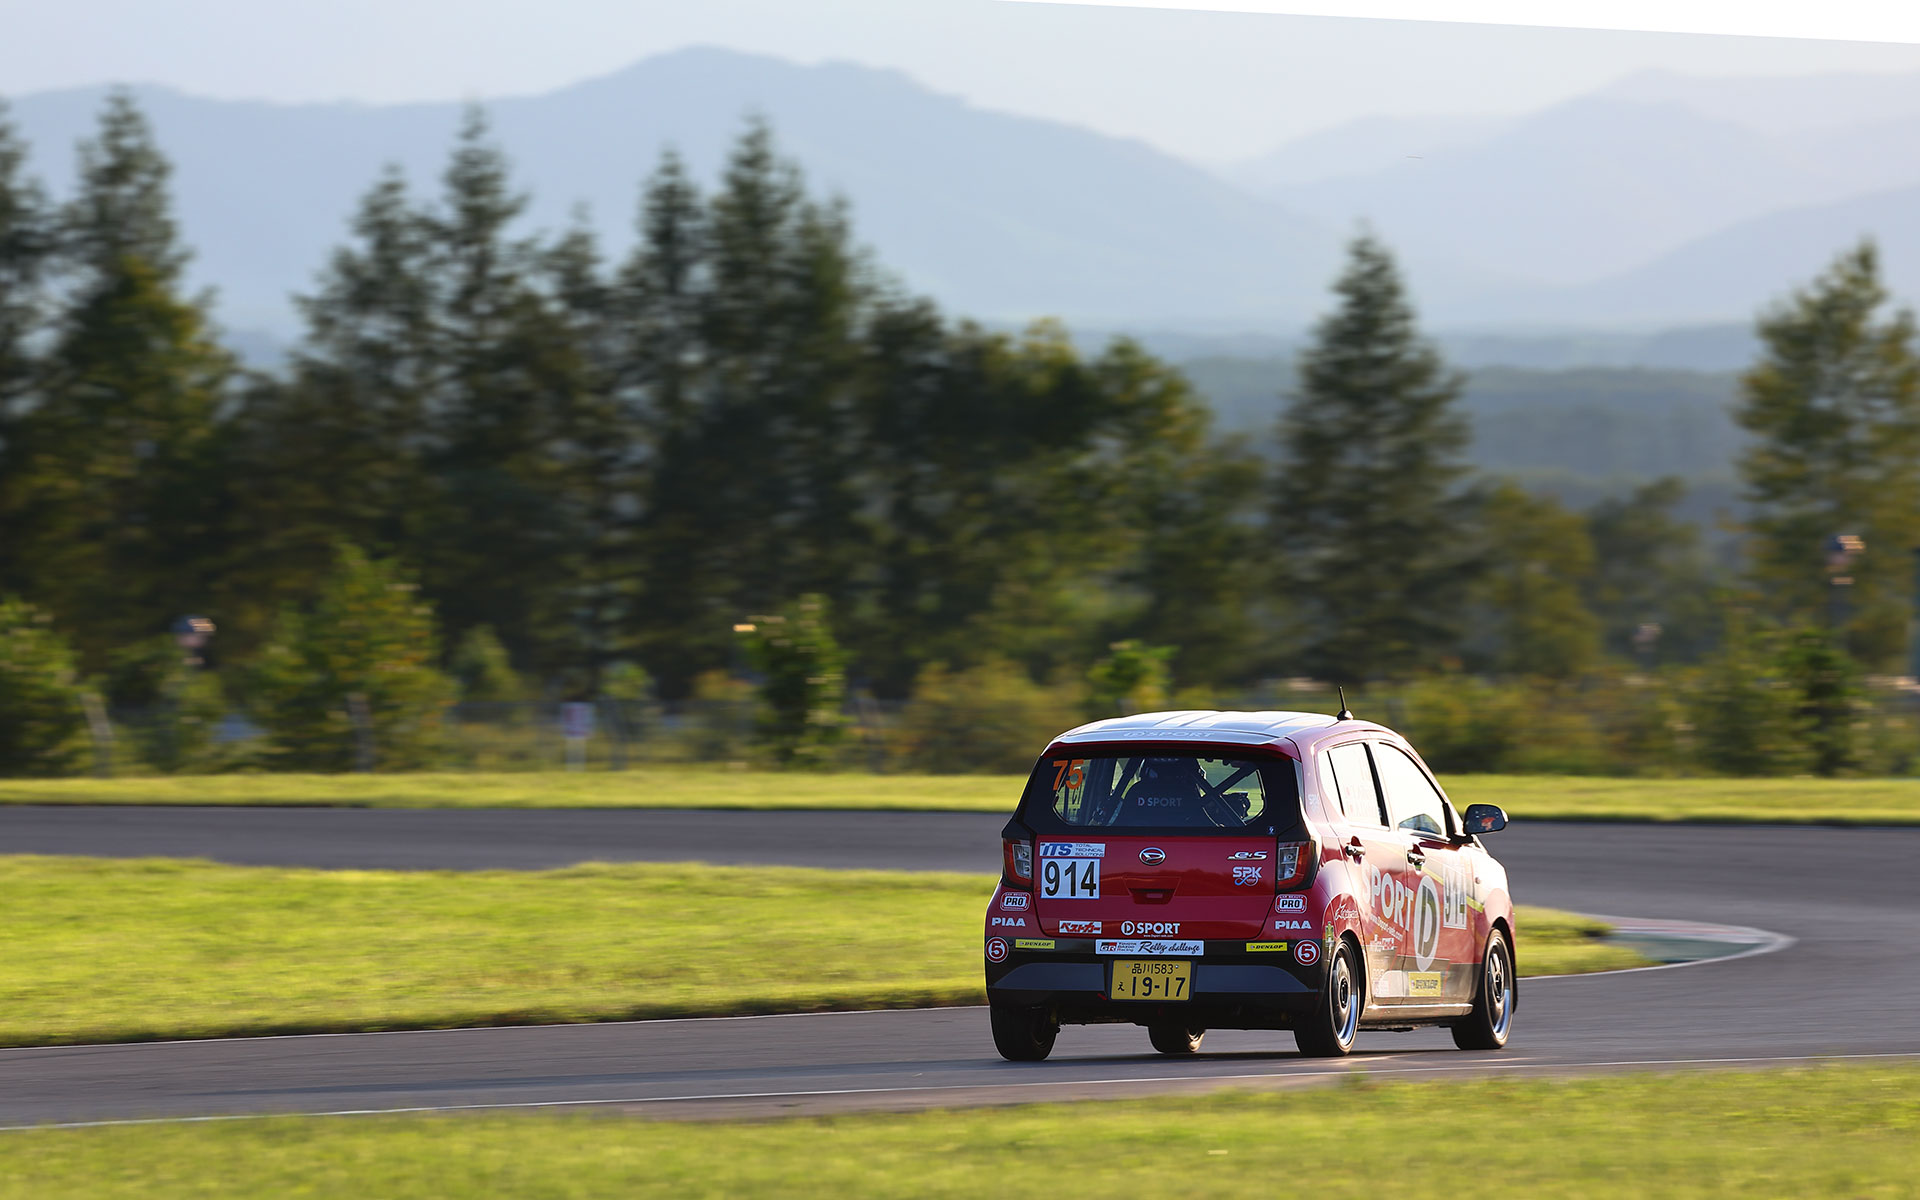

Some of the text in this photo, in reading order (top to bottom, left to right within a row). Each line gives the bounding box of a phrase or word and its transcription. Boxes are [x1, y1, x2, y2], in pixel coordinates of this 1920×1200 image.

[1053, 759, 1084, 791] 75
[1137, 797, 1182, 807] D SPORT
[1044, 860, 1097, 897] 914
[1232, 866, 1263, 879] SPK
[1005, 897, 1024, 906] PRO
[1443, 866, 1466, 928] 914
[1281, 899, 1301, 908] PRO
[991, 917, 1026, 927] PIAA
[1136, 922, 1181, 934] SPORT
[1275, 920, 1312, 930] PIAA
[1138, 941, 1168, 954] Rally
[1168, 942, 1201, 955] challenge
[1132, 976, 1186, 998] 19-17
